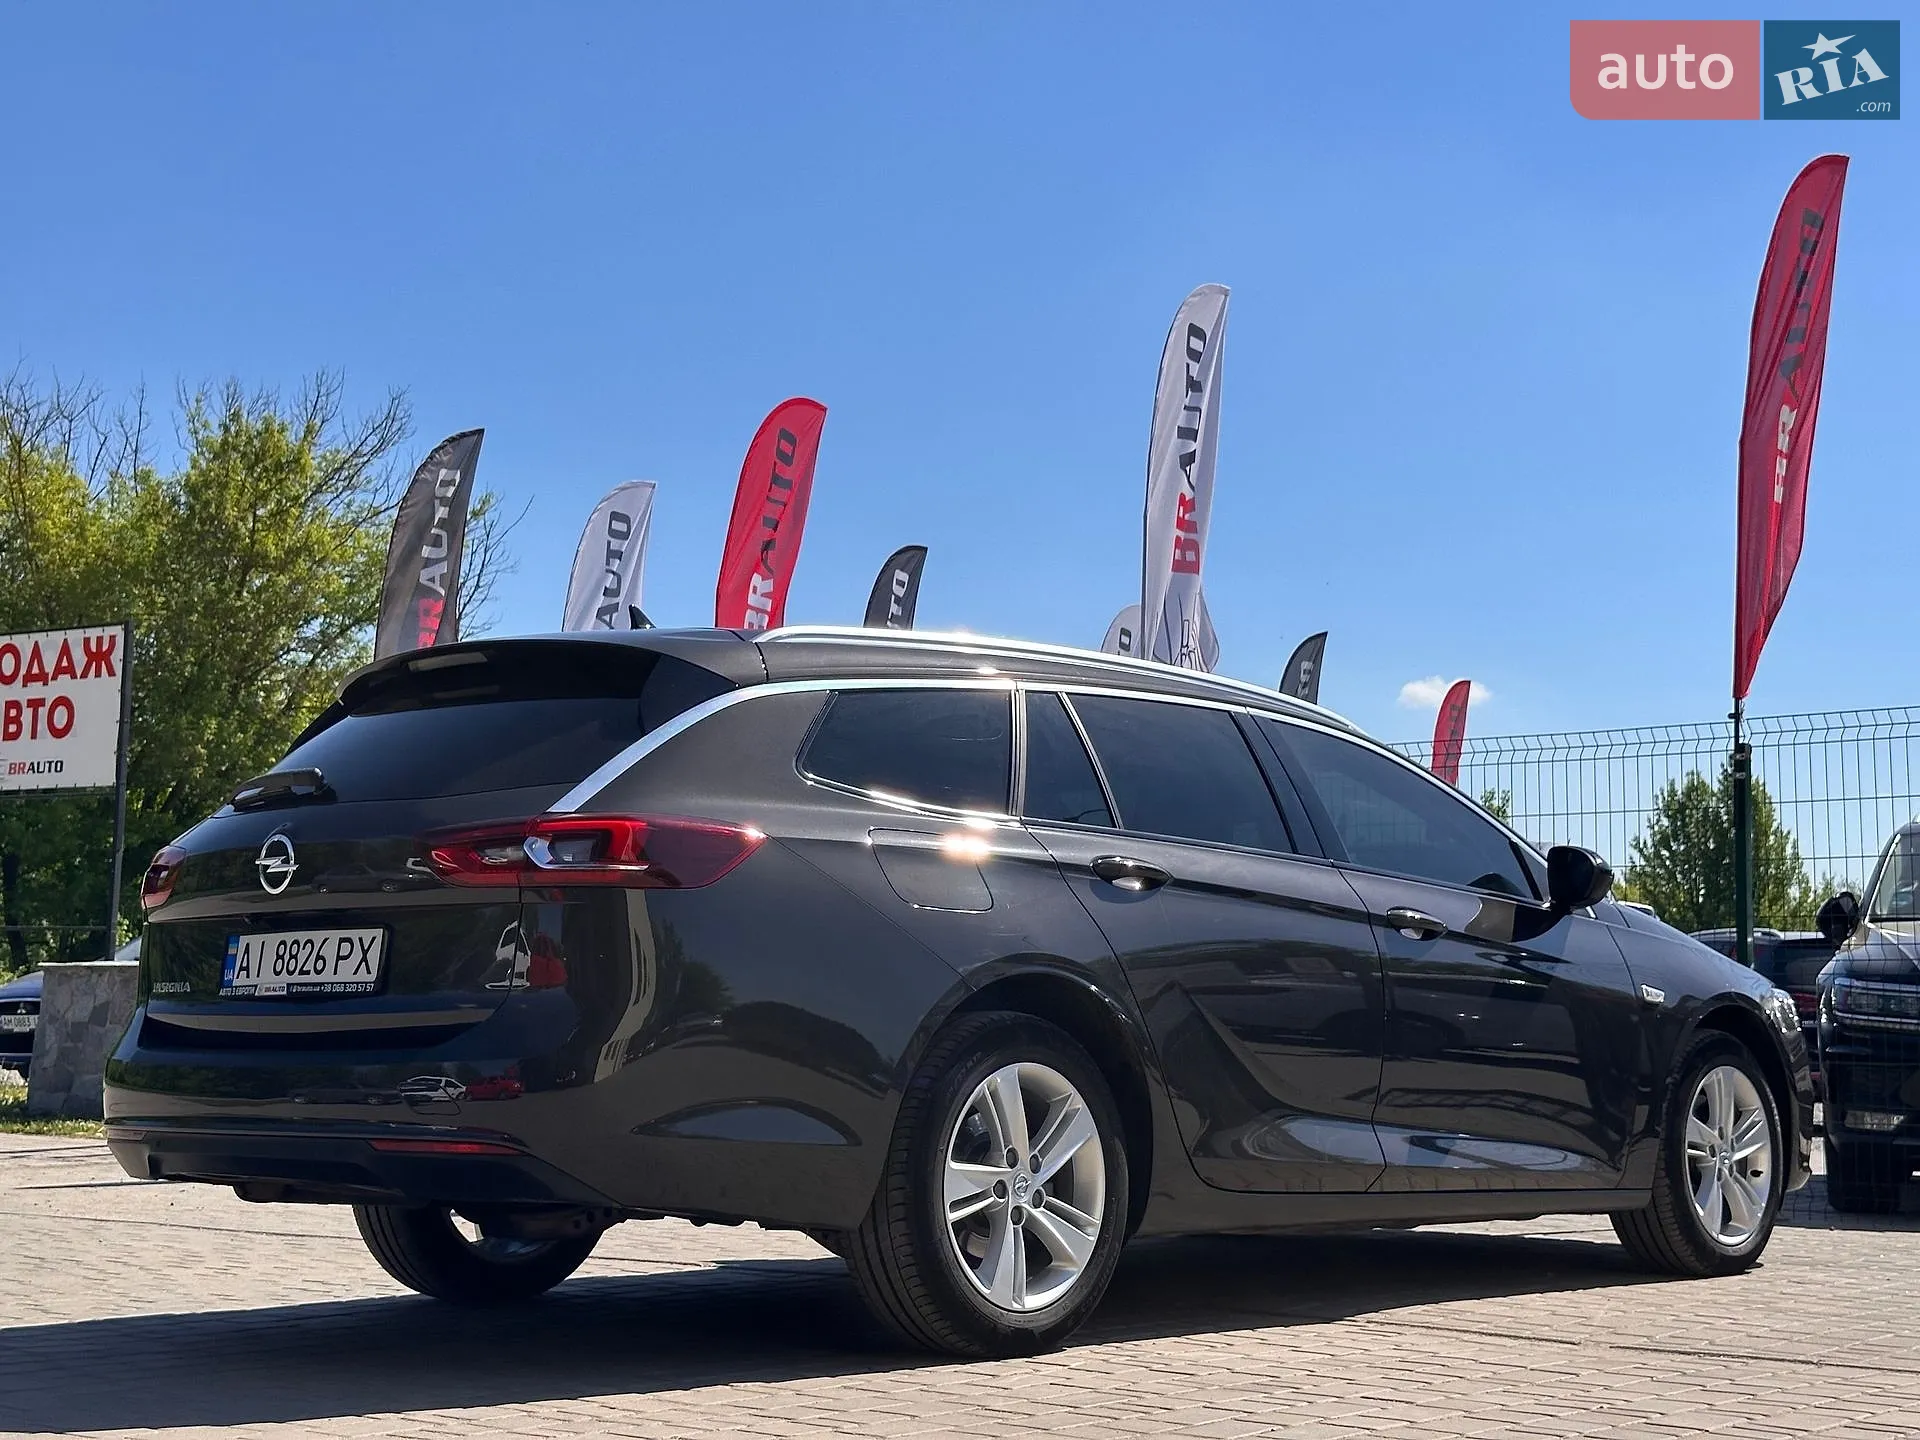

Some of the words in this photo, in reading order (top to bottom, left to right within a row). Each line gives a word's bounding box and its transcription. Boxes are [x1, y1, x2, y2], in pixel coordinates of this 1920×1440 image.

[1171, 322, 1206, 576] BRAUTO
[0, 634, 117, 688] ОДАЖ
[2, 695, 75, 742] ВТО
[8, 759, 64, 775] BRAUTO
[236, 941, 265, 979] AI
[272, 937, 330, 977] 8826
[333, 936, 377, 976] PX
